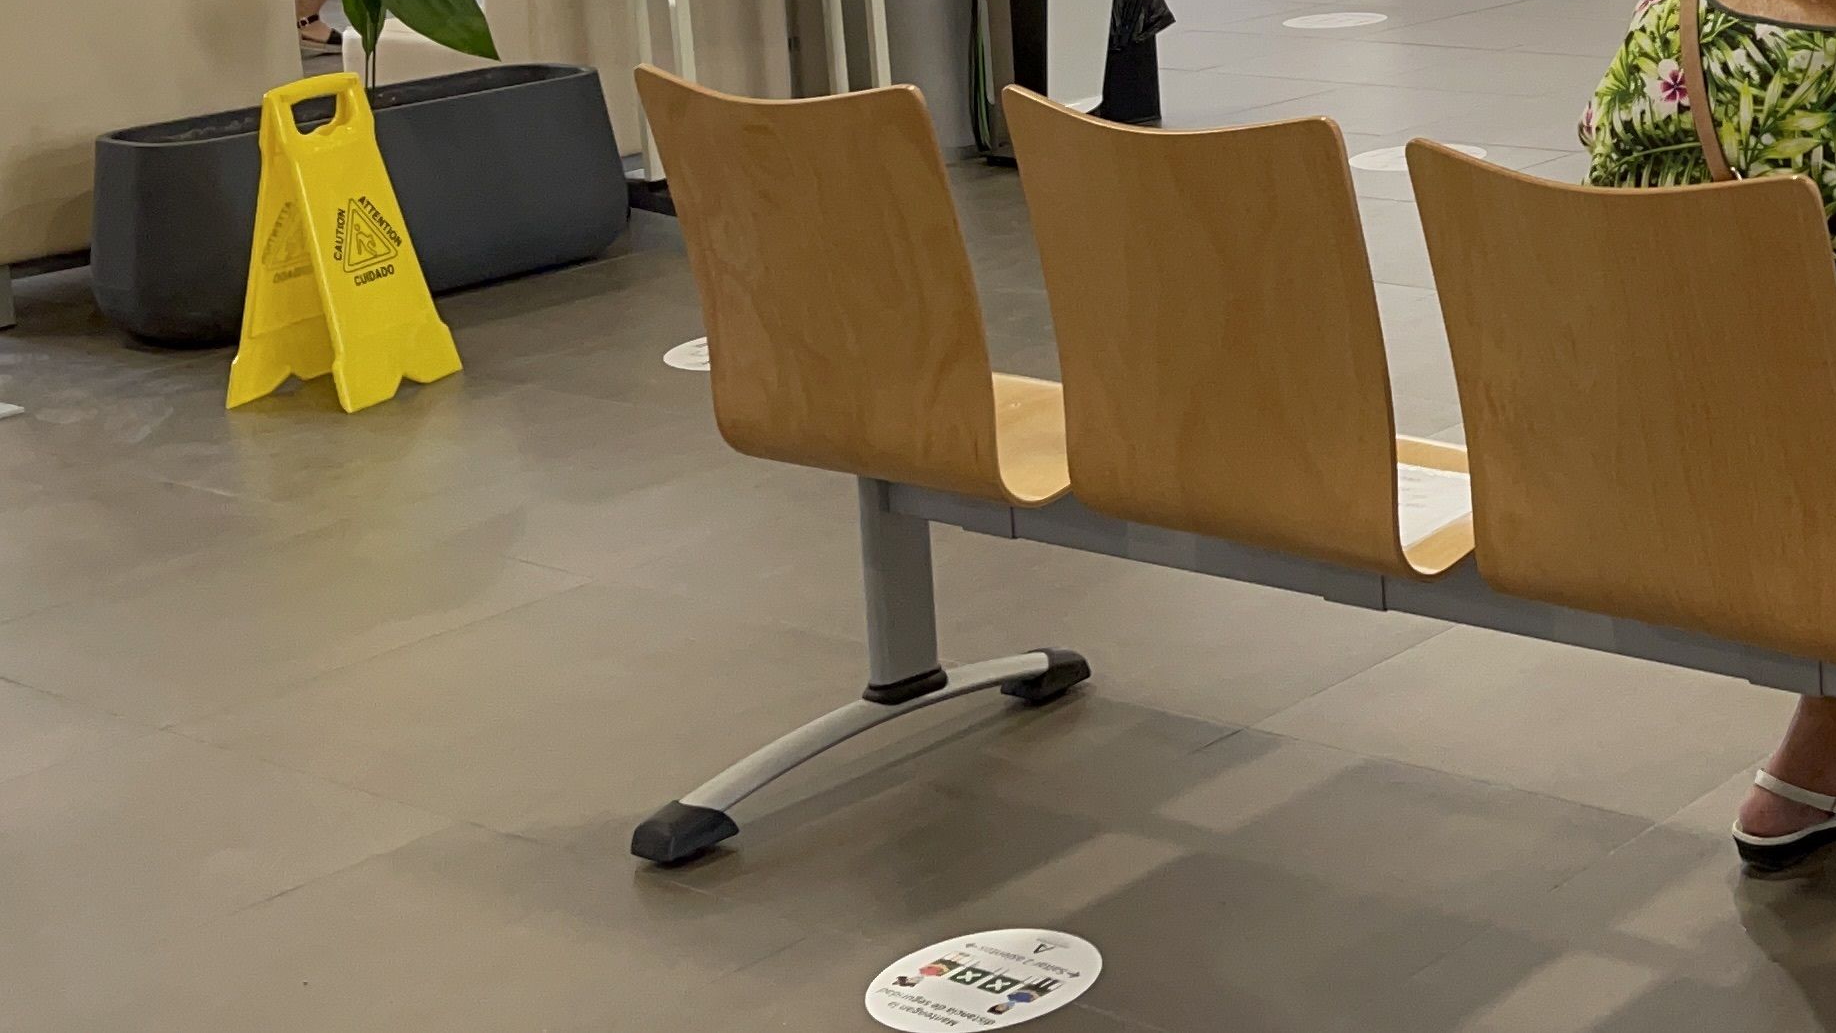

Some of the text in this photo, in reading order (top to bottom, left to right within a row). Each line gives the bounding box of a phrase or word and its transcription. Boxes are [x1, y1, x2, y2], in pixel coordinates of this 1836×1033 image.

[358, 195, 402, 248] ATTENTION
[333, 208, 345, 261] CAUTION
[353, 264, 395, 287] CUIDADO
[931, 1002, 947, 1014] de
[947, 1007, 996, 1026] distancia
